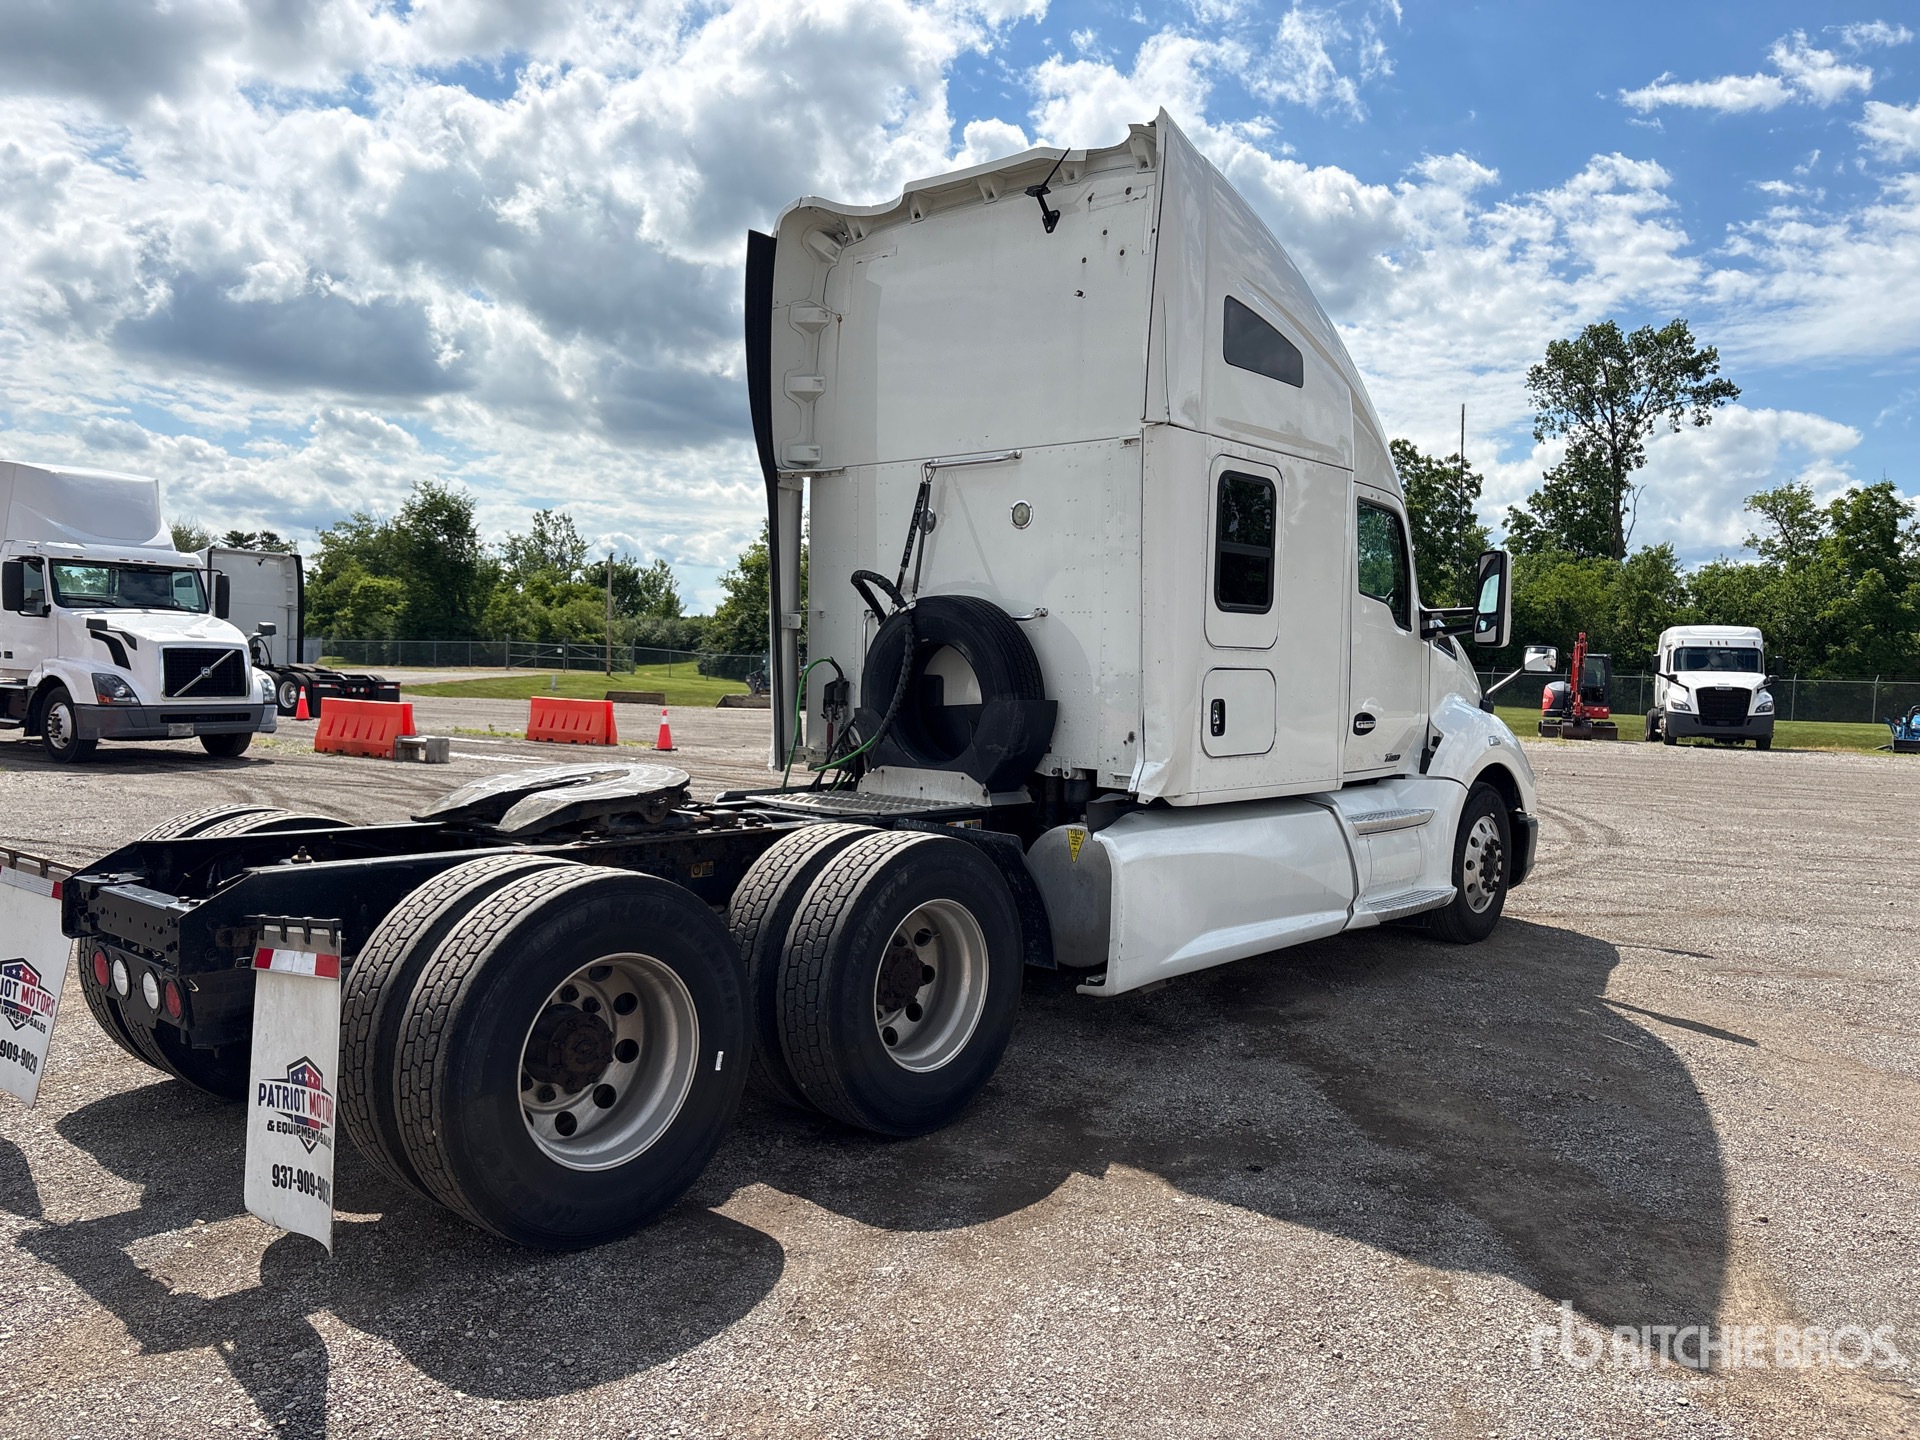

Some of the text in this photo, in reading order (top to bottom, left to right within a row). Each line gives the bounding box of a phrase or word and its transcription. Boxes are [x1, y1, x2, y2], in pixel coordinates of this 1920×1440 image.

[21, 984, 56, 1018] MOTORS
[0, 1005, 47, 1034] IPMENT SALES
[258, 1082, 333, 1126] PATRIOT MOTOR
[267, 1120, 275, 1132] &
[276, 1121, 319, 1142] EQUIPMENT
[271, 1163, 331, 1209] 937-909-902
